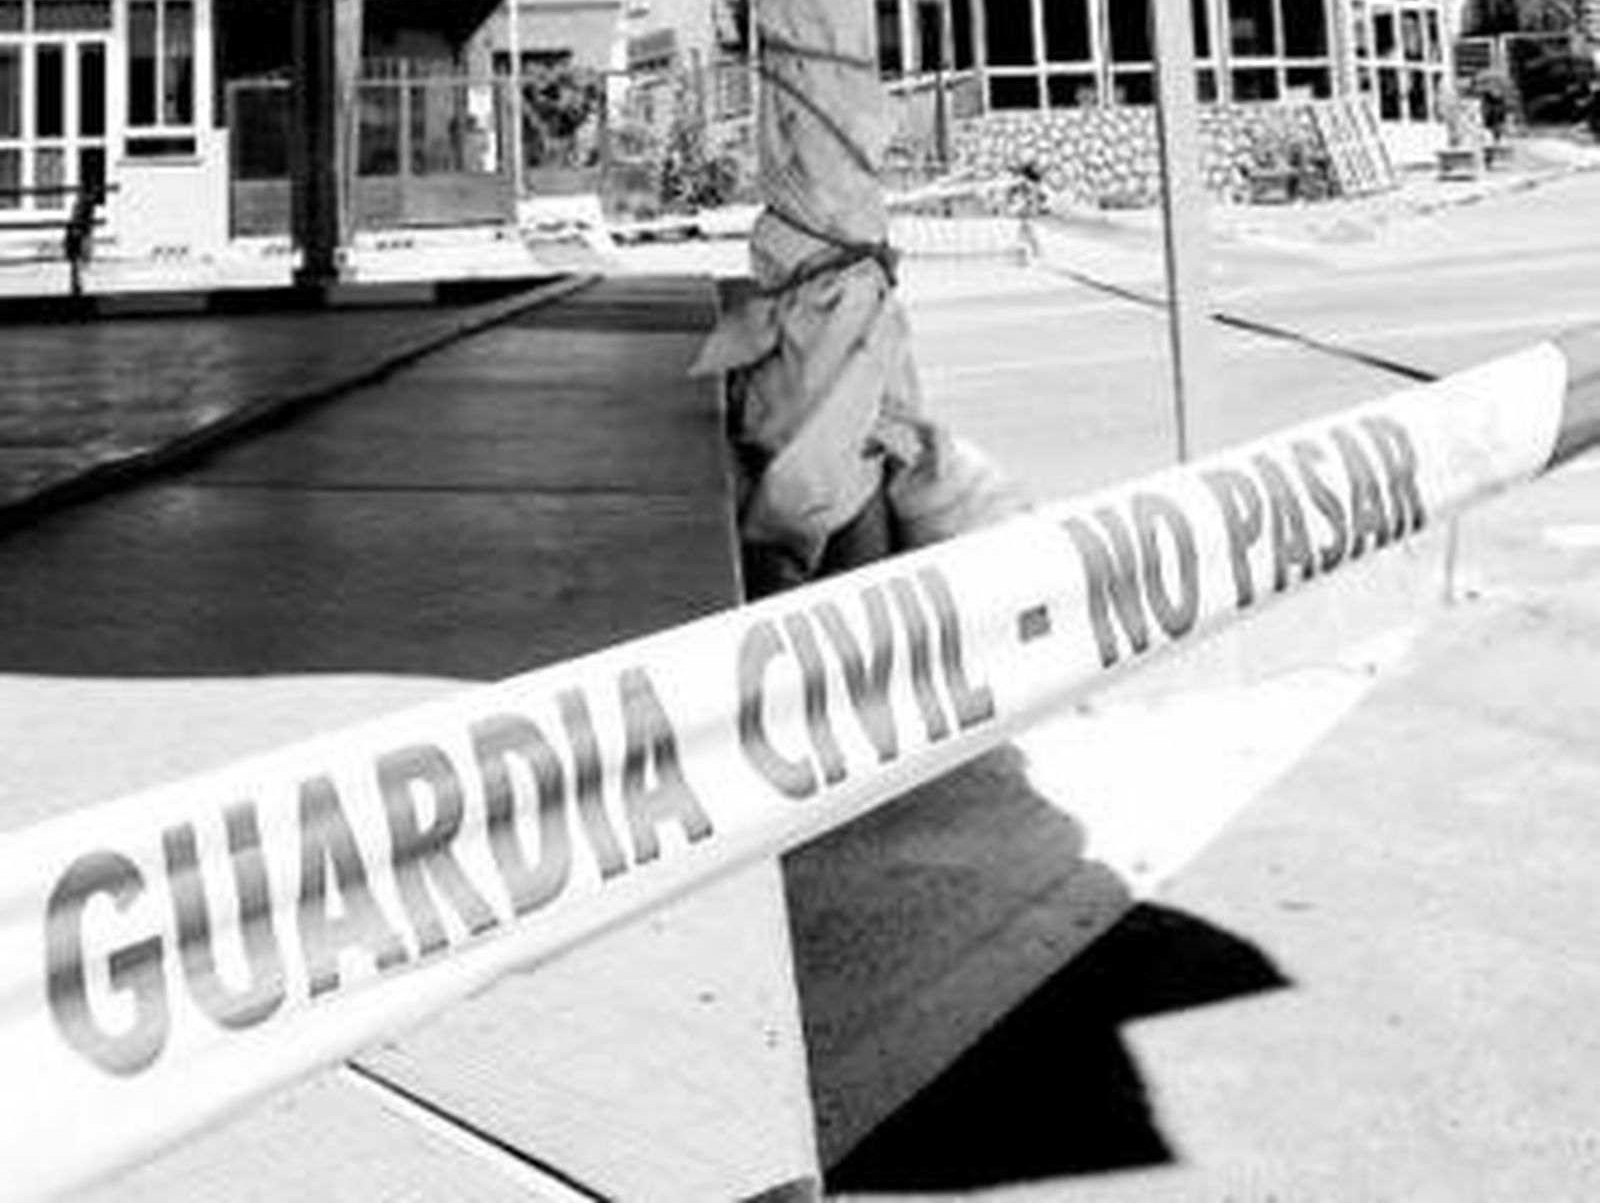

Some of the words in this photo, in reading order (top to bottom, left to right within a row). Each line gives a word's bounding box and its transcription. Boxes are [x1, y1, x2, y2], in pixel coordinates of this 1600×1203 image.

[45, 665, 713, 1078] GUARDIA
[736, 566, 996, 801] CIVIL
[1017, 603, 1052, 643] -
[1063, 494, 1201, 669] NO
[1203, 414, 1426, 609] PASAR
